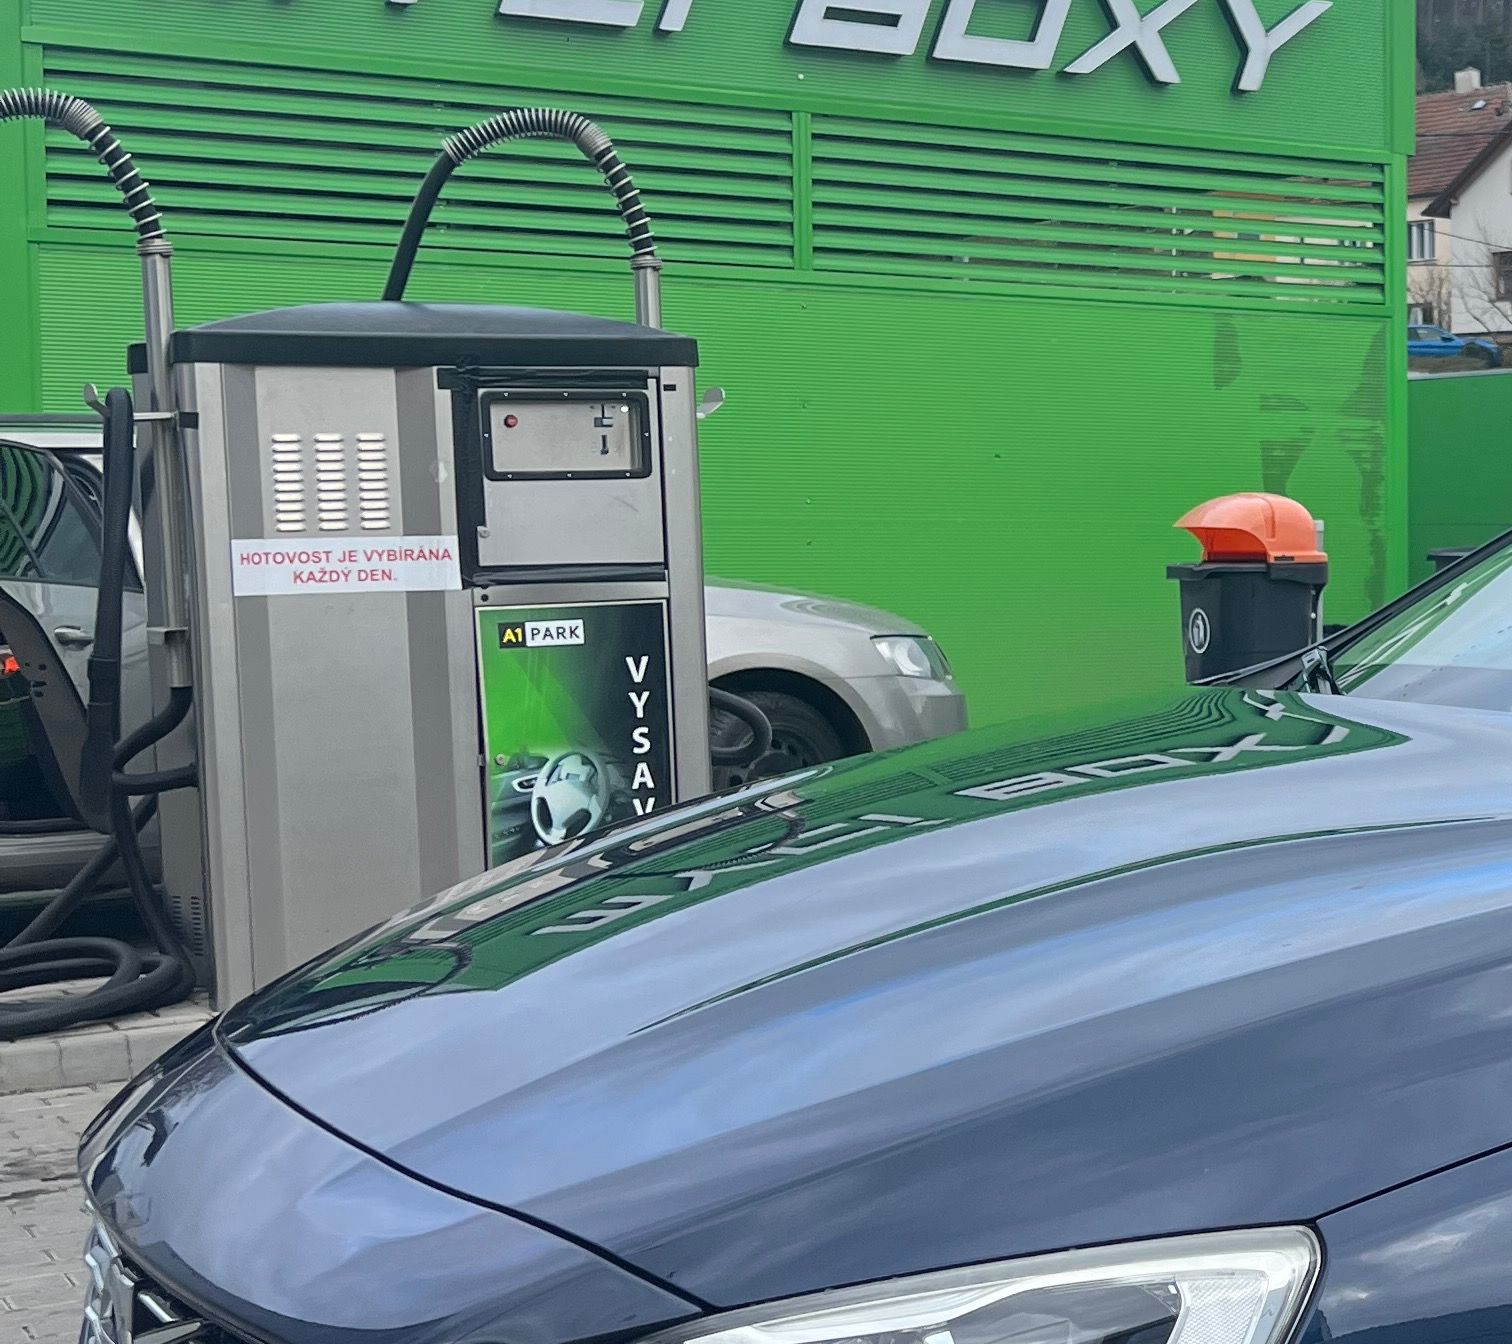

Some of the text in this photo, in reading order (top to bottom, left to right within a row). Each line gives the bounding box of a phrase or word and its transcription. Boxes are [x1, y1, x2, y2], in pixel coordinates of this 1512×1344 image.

[240, 545, 453, 566] HOTOVOST JE VYBÍRÁNA
[293, 567, 398, 585] KAŽDÝ DEN.
[502, 624, 581, 644] A1 PARK
[625, 655, 656, 817] VYSAV
